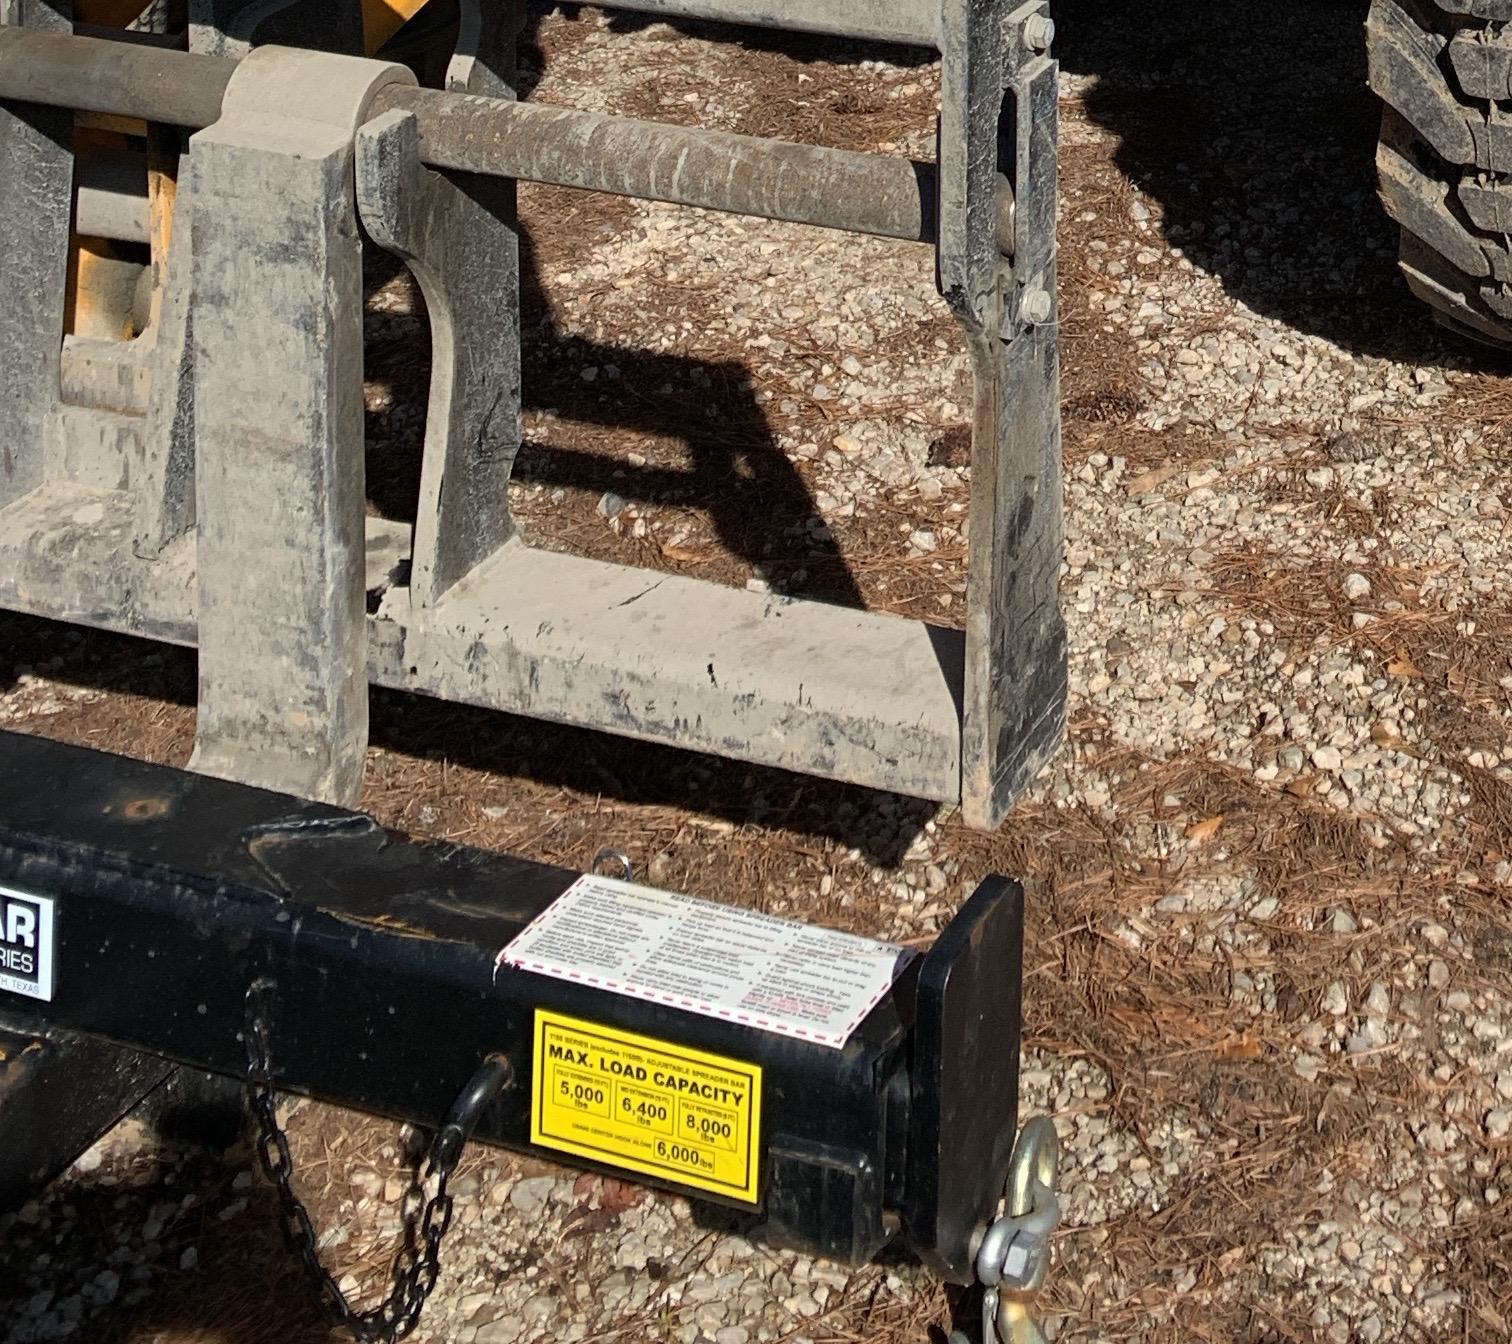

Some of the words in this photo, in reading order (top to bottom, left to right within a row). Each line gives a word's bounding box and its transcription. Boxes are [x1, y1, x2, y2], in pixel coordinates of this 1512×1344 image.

[549, 1043, 593, 1068] MAX.
[600, 1057, 647, 1082] LOAD
[653, 1072, 744, 1107] CAPACITY
[560, 1080, 604, 1104] 5,000
[574, 1099, 588, 1109] lbs
[622, 1097, 667, 1121] 6,400
[637, 1116, 651, 1126] lbs
[686, 1114, 731, 1138] 8,000
[700, 1132, 715, 1143] lbs
